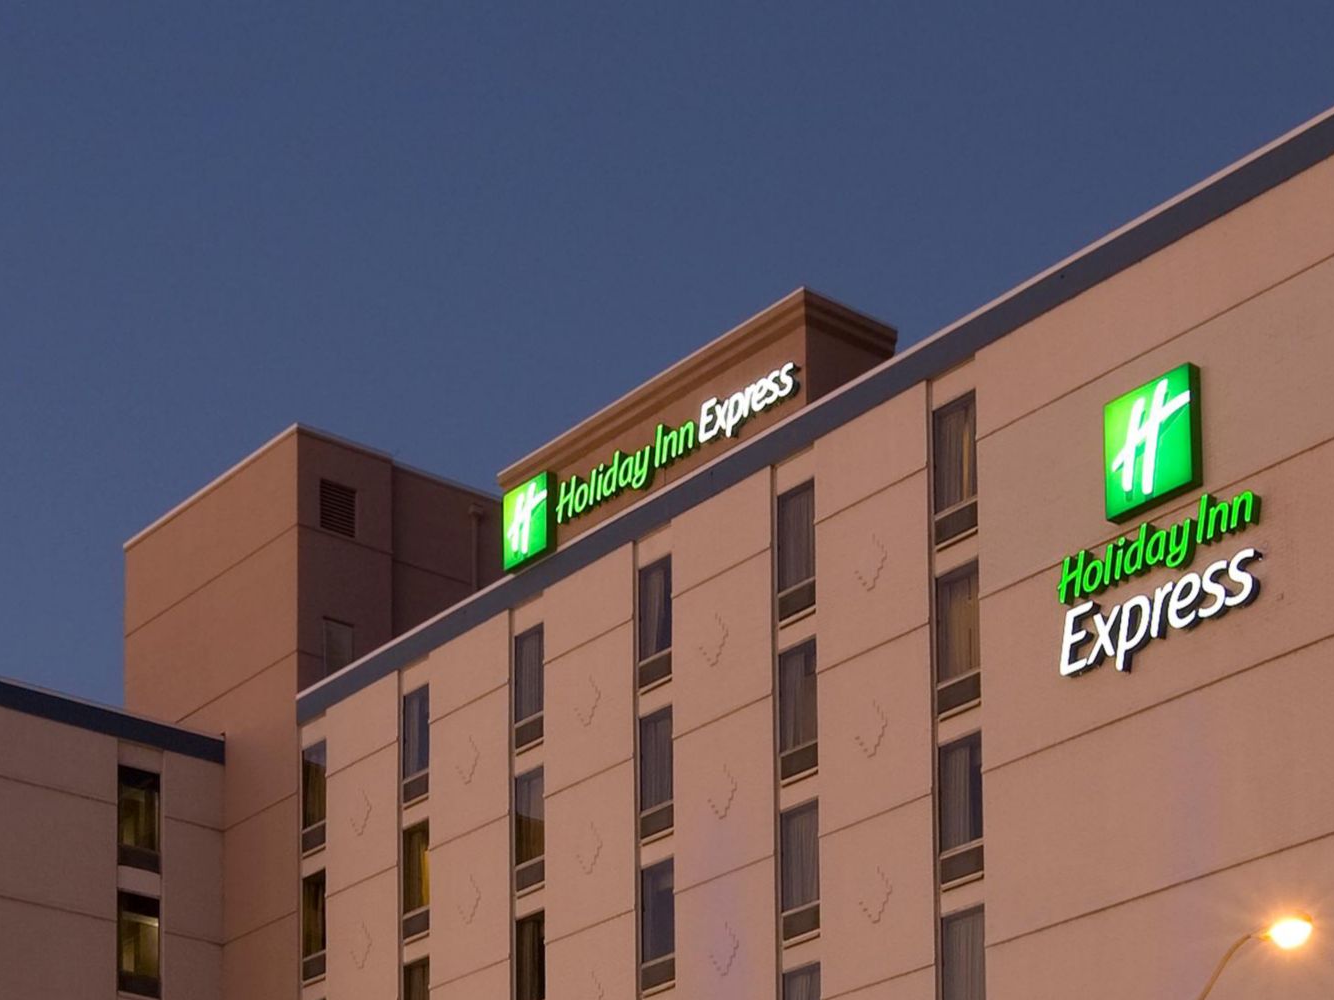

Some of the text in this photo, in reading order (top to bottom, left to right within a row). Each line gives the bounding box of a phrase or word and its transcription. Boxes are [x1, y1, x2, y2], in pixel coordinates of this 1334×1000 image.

[555, 361, 795, 524] Holiday Inn Express
[1057, 490, 1254, 604] Holiday Inn
[1059, 547, 1255, 677] Express
